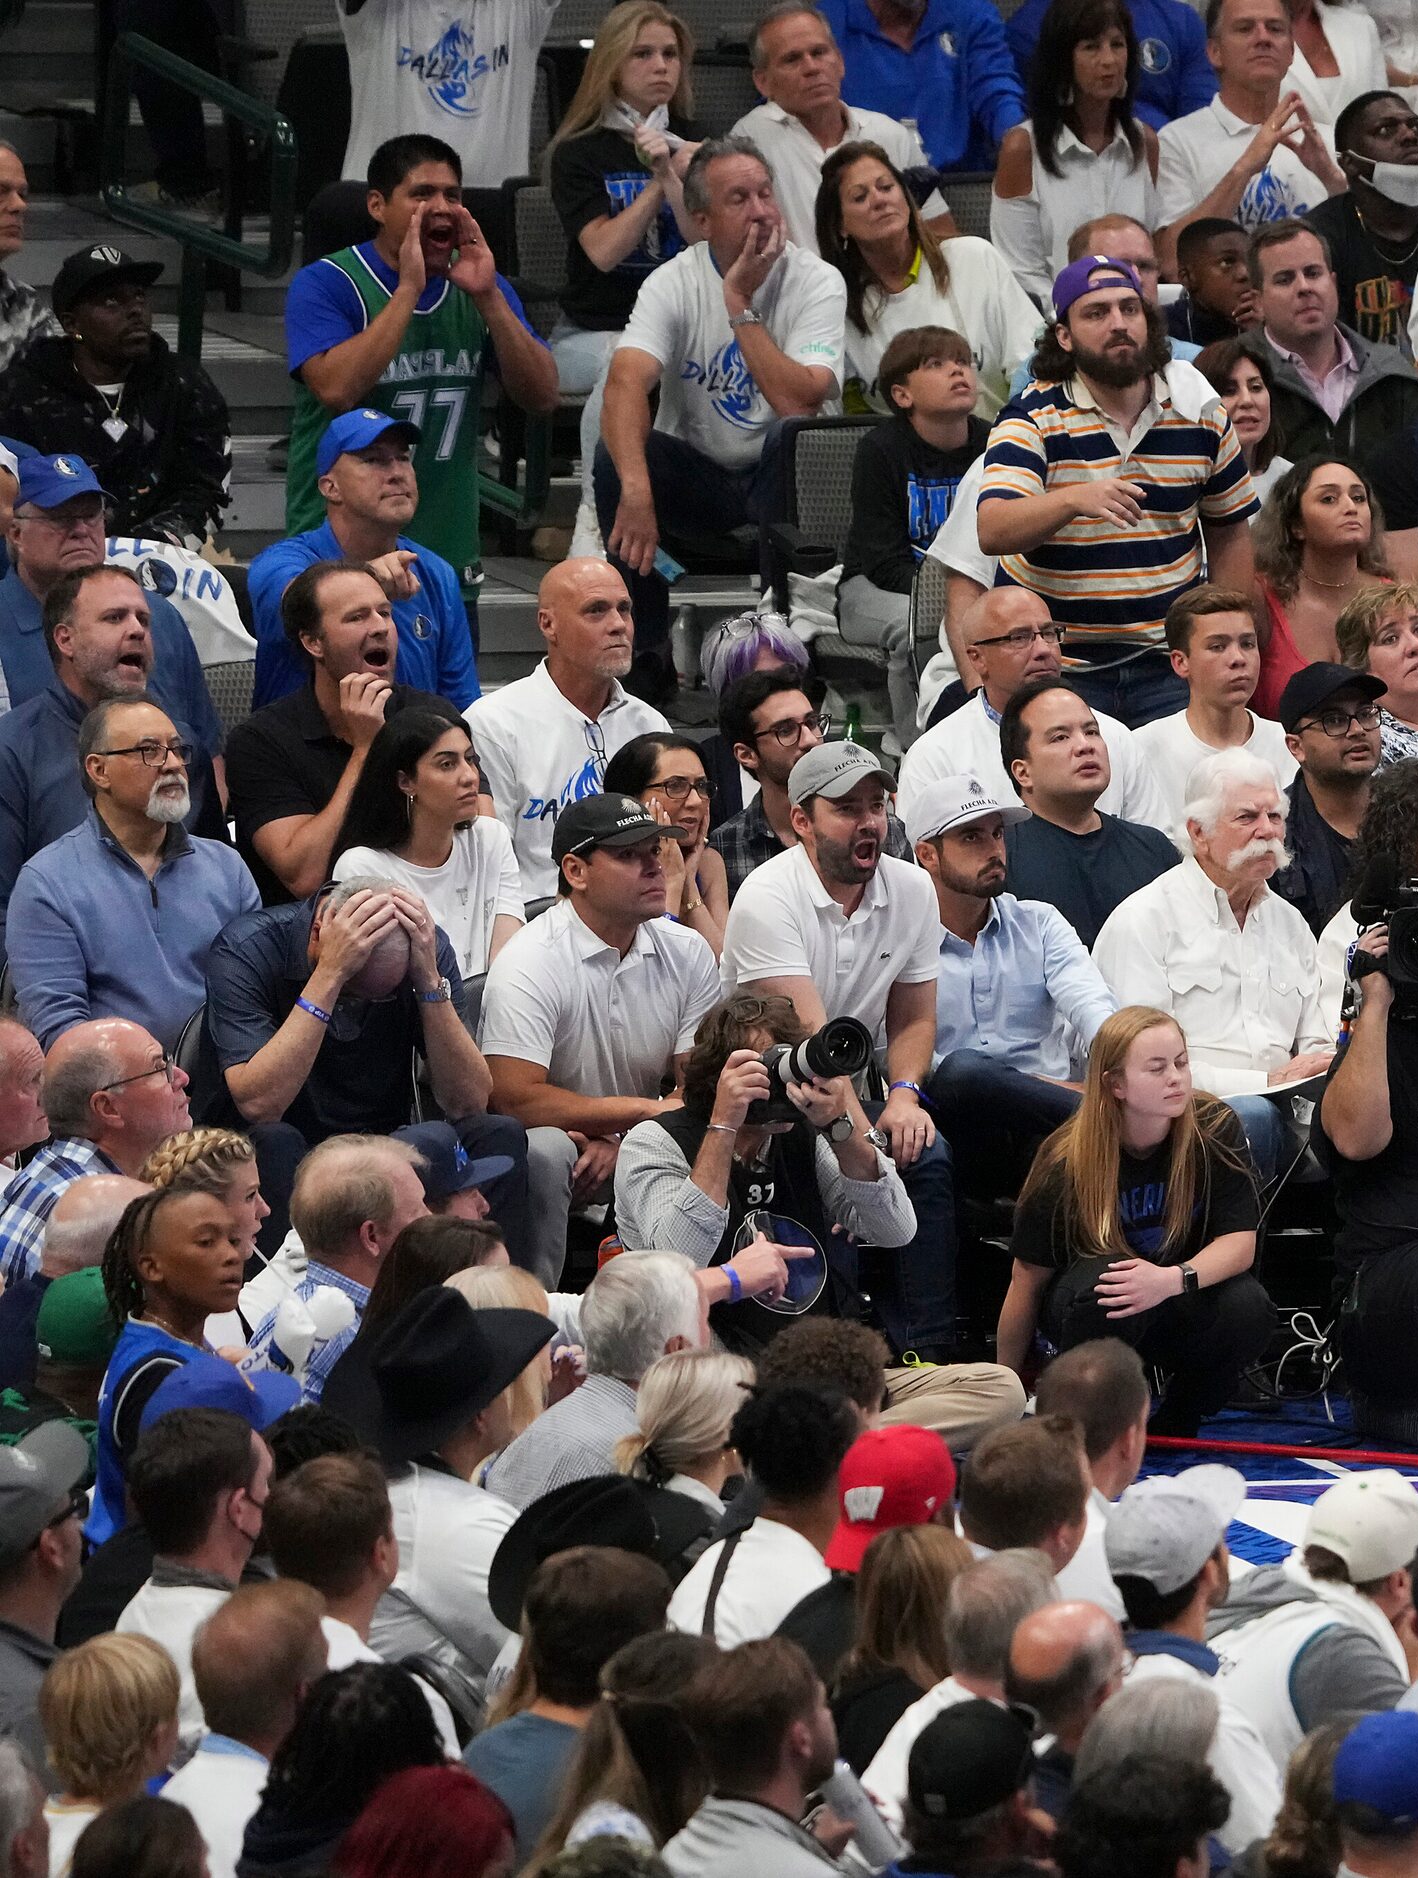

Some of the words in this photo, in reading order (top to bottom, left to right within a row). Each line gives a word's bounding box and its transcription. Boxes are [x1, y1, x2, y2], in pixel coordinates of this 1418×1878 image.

[397, 46, 489, 83] DALLAS
[492, 44, 510, 72] IN
[391, 386, 470, 461] 77
[960, 799, 986, 811] FLECHA
[616, 814, 642, 827] FLECHA
[747, 1182, 775, 1205] 37
